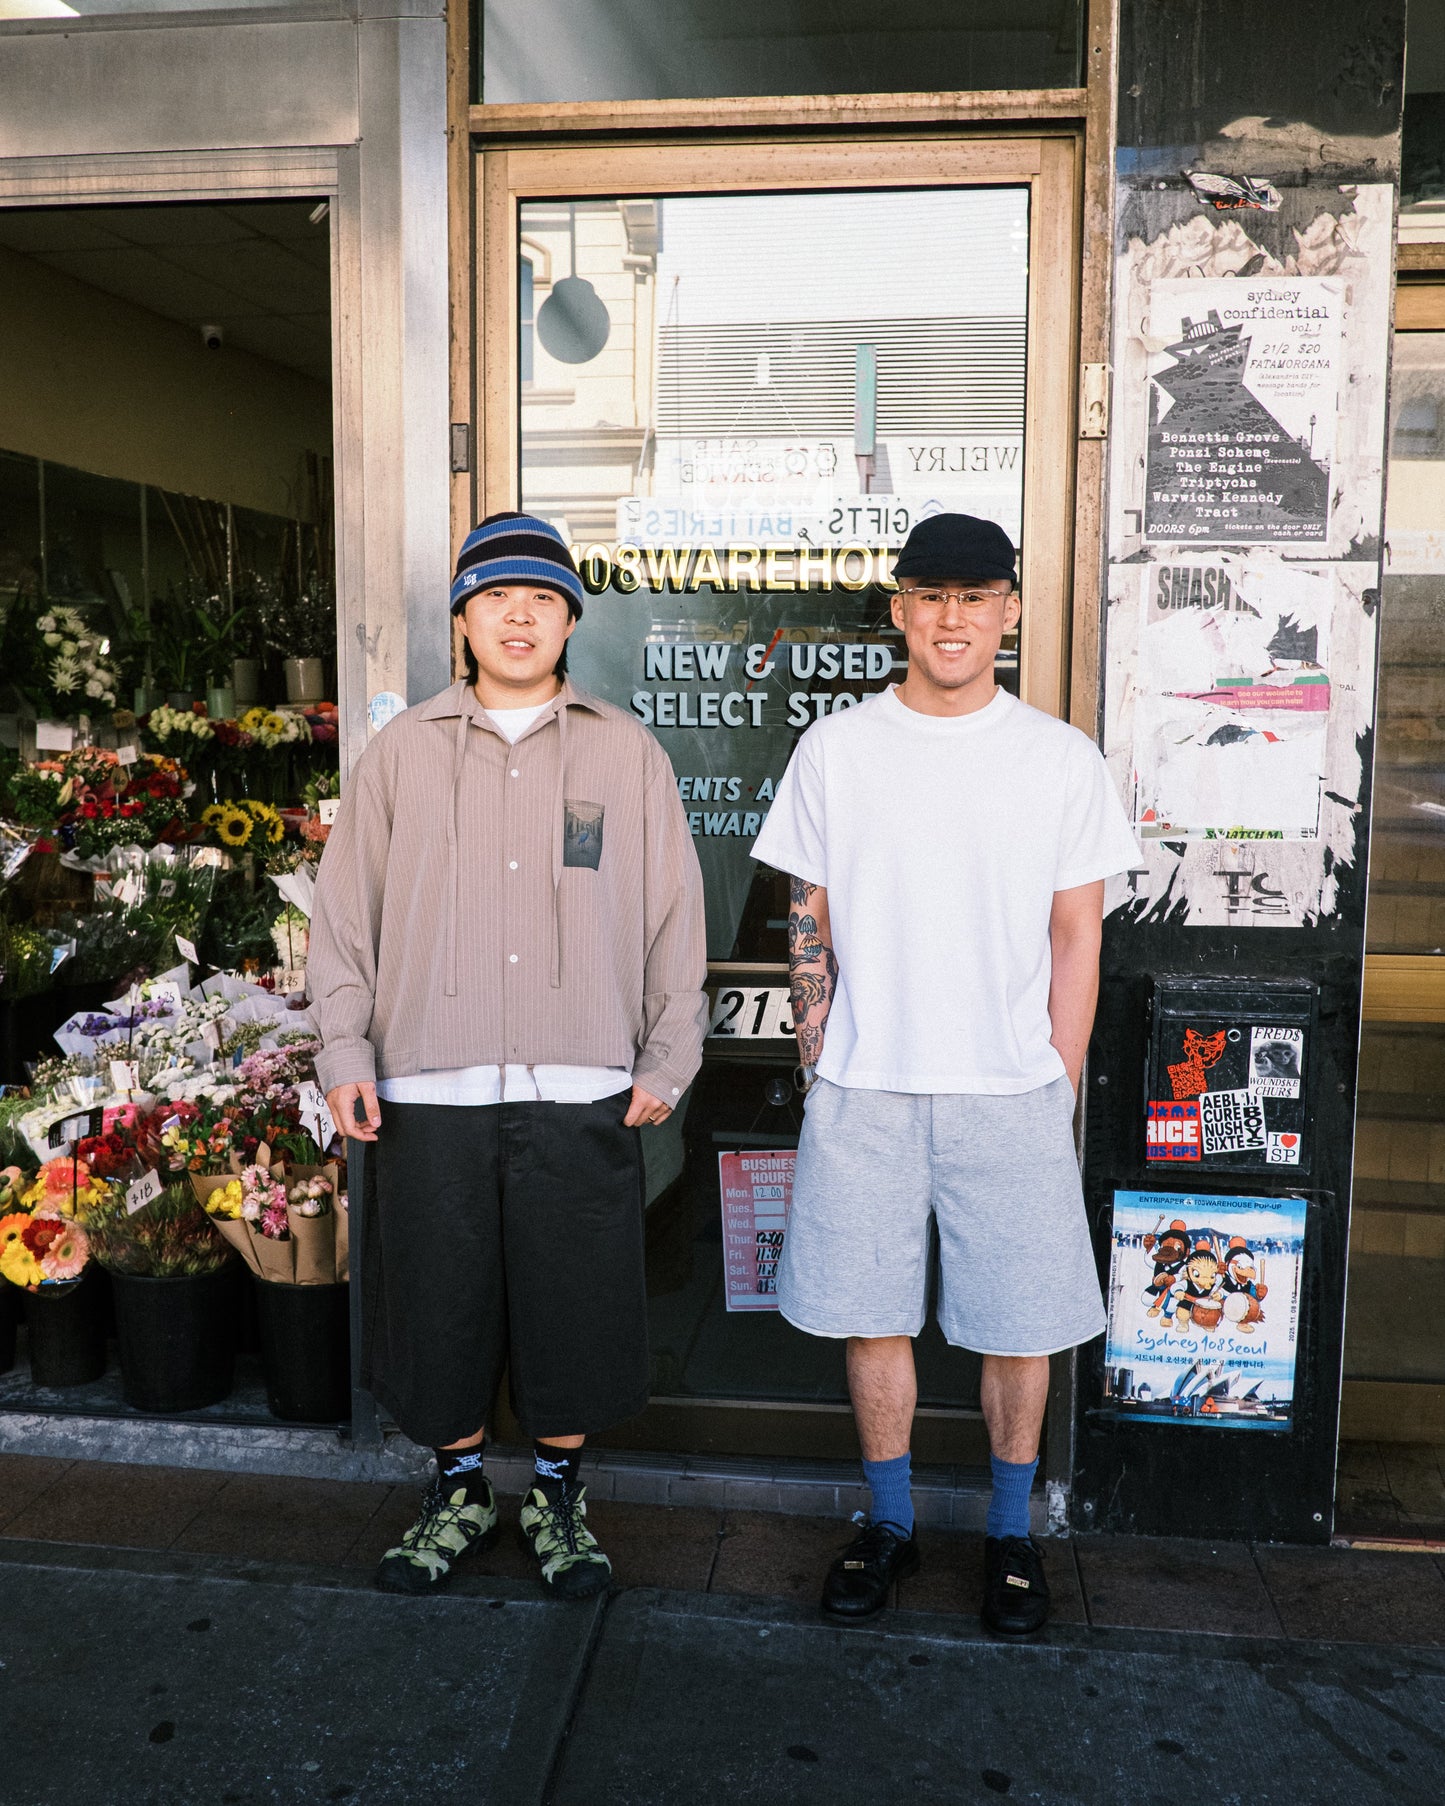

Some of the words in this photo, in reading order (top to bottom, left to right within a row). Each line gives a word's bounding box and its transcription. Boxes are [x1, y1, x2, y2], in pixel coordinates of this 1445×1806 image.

[1223, 306, 1330, 320] confidential
[1291, 324, 1312, 333] vol.
[1262, 343, 1290, 355] 21/2
[1298, 343, 1321, 355] $20
[1249, 359, 1331, 370] FATAMORGANA
[1160, 432, 1230, 443] Bennetts
[1235, 432, 1280, 443] Grove
[1169, 447, 1211, 458] Ponzi
[1217, 447, 1271, 458] Scheme
[1176, 462, 1202, 473] The
[1208, 462, 1262, 475] Engine
[1180, 476, 1257, 489] Triptychs
[1152, 492, 1215, 503] Warwick
[1222, 492, 1284, 505] Kennedy
[1195, 506, 1239, 518] Tract
[1148, 524, 1186, 534] DOORS
[1188, 524, 1210, 535] 6pm
[644, 644, 731, 680] NEW
[744, 643, 776, 680] &
[790, 644, 894, 680] USED
[630, 691, 768, 728] SELECT
[785, 691, 877, 728] STO
[675, 776, 743, 802] ENTS
[685, 811, 768, 837] EWAR
[1202, 1093, 1241, 1110] AEBL
[1203, 1106, 1242, 1123] CURE
[1204, 1121, 1244, 1138] NUSH
[1242, 1106, 1265, 1148] BOYS
[1205, 1135, 1245, 1152] SIXTE
[1272, 1133, 1280, 1147] I
[1270, 1148, 1296, 1163] SP
[751, 1171, 795, 1184] HOURS
[131, 1182, 153, 1205] $18
[725, 1187, 751, 1198] Mon.
[726, 1203, 753, 1213] Tues.
[727, 1218, 752, 1229] Wed.
[728, 1234, 753, 1244] Thur.
[728, 1249, 746, 1260] Fri.
[729, 1264, 750, 1276] Sat.
[730, 1280, 753, 1291] Sun.
[1135, 1329, 1199, 1354] Sydney
[1201, 1335, 1225, 1352] 108
[1227, 1338, 1267, 1355] Seoul
